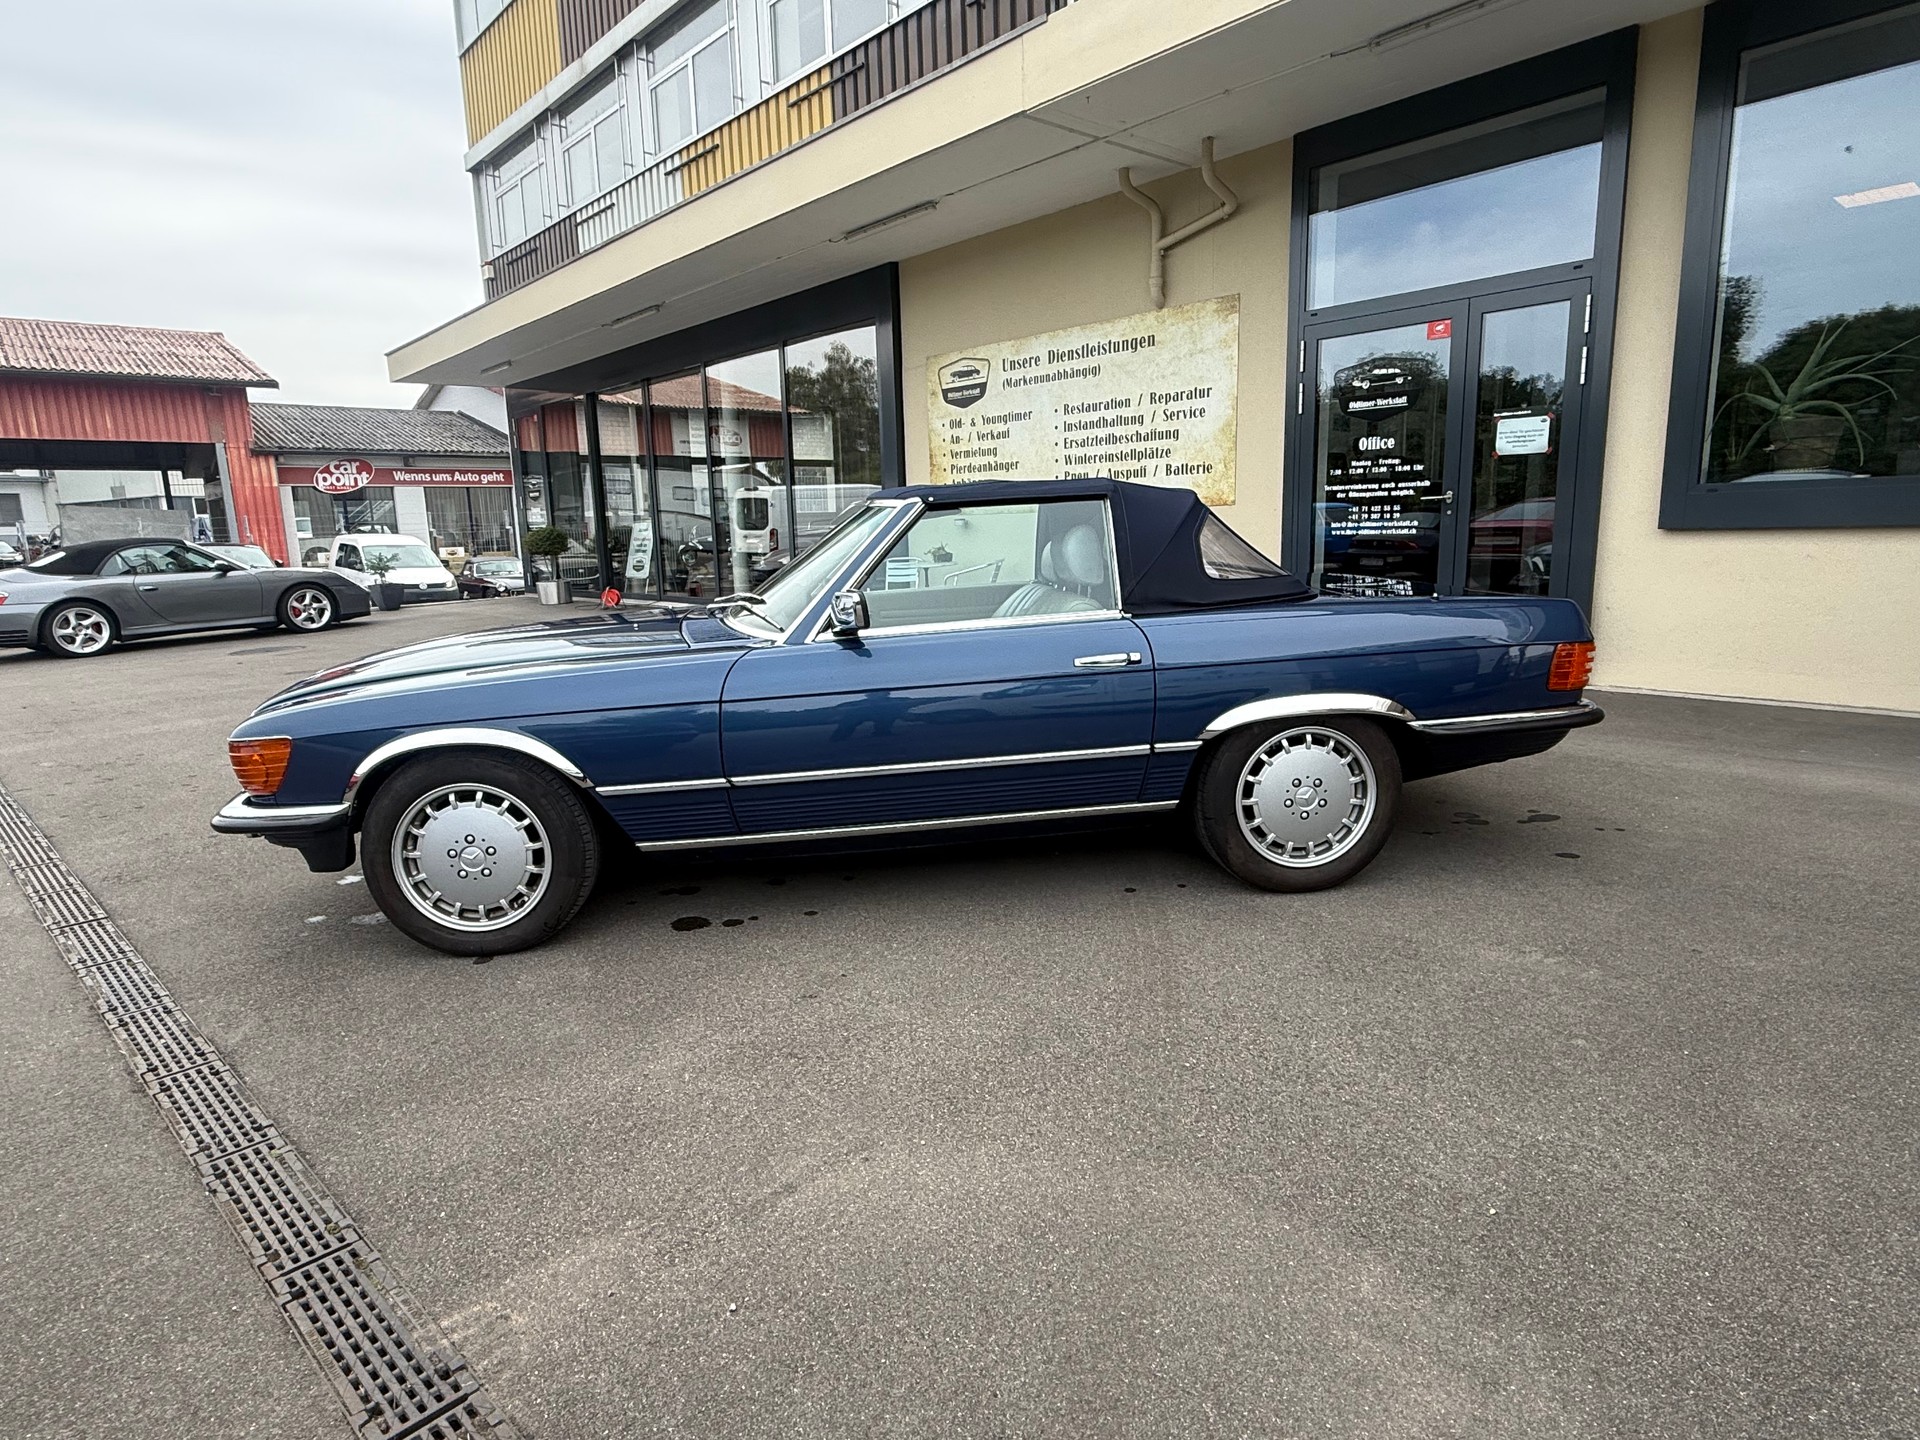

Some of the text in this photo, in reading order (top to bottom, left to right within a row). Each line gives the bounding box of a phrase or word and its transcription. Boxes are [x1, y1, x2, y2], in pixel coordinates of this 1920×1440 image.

[1002, 333, 1156, 372] Unsere Dienstleistungen
[1002, 363, 1101, 391] (Markenunabhängig)
[1063, 386, 1213, 416] Restauration / Reparatur
[949, 410, 1033, 430] Old- & Youngtimer
[1063, 406, 1206, 433] Instandhaltung / Service
[950, 427, 1010, 445] An- / Verkauf
[1063, 428, 1180, 450] Ersatzteilbeschaffung
[1358, 436, 1396, 451] Office
[950, 446, 998, 460] Vermietung
[1064, 446, 1172, 466] Wintereinstellplätze
[329, 461, 360, 474] car
[392, 470, 431, 482] Wenns
[453, 471, 479, 482] Auto
[480, 471, 505, 484] geht
[950, 460, 1020, 475] Pferdeanhänger
[1064, 470, 1089, 480] Pneu
[1107, 464, 1147, 481] Auspuff
[1153, 464, 1158, 477] /
[1165, 461, 1213, 477] Batterie
[317, 471, 369, 489] point
